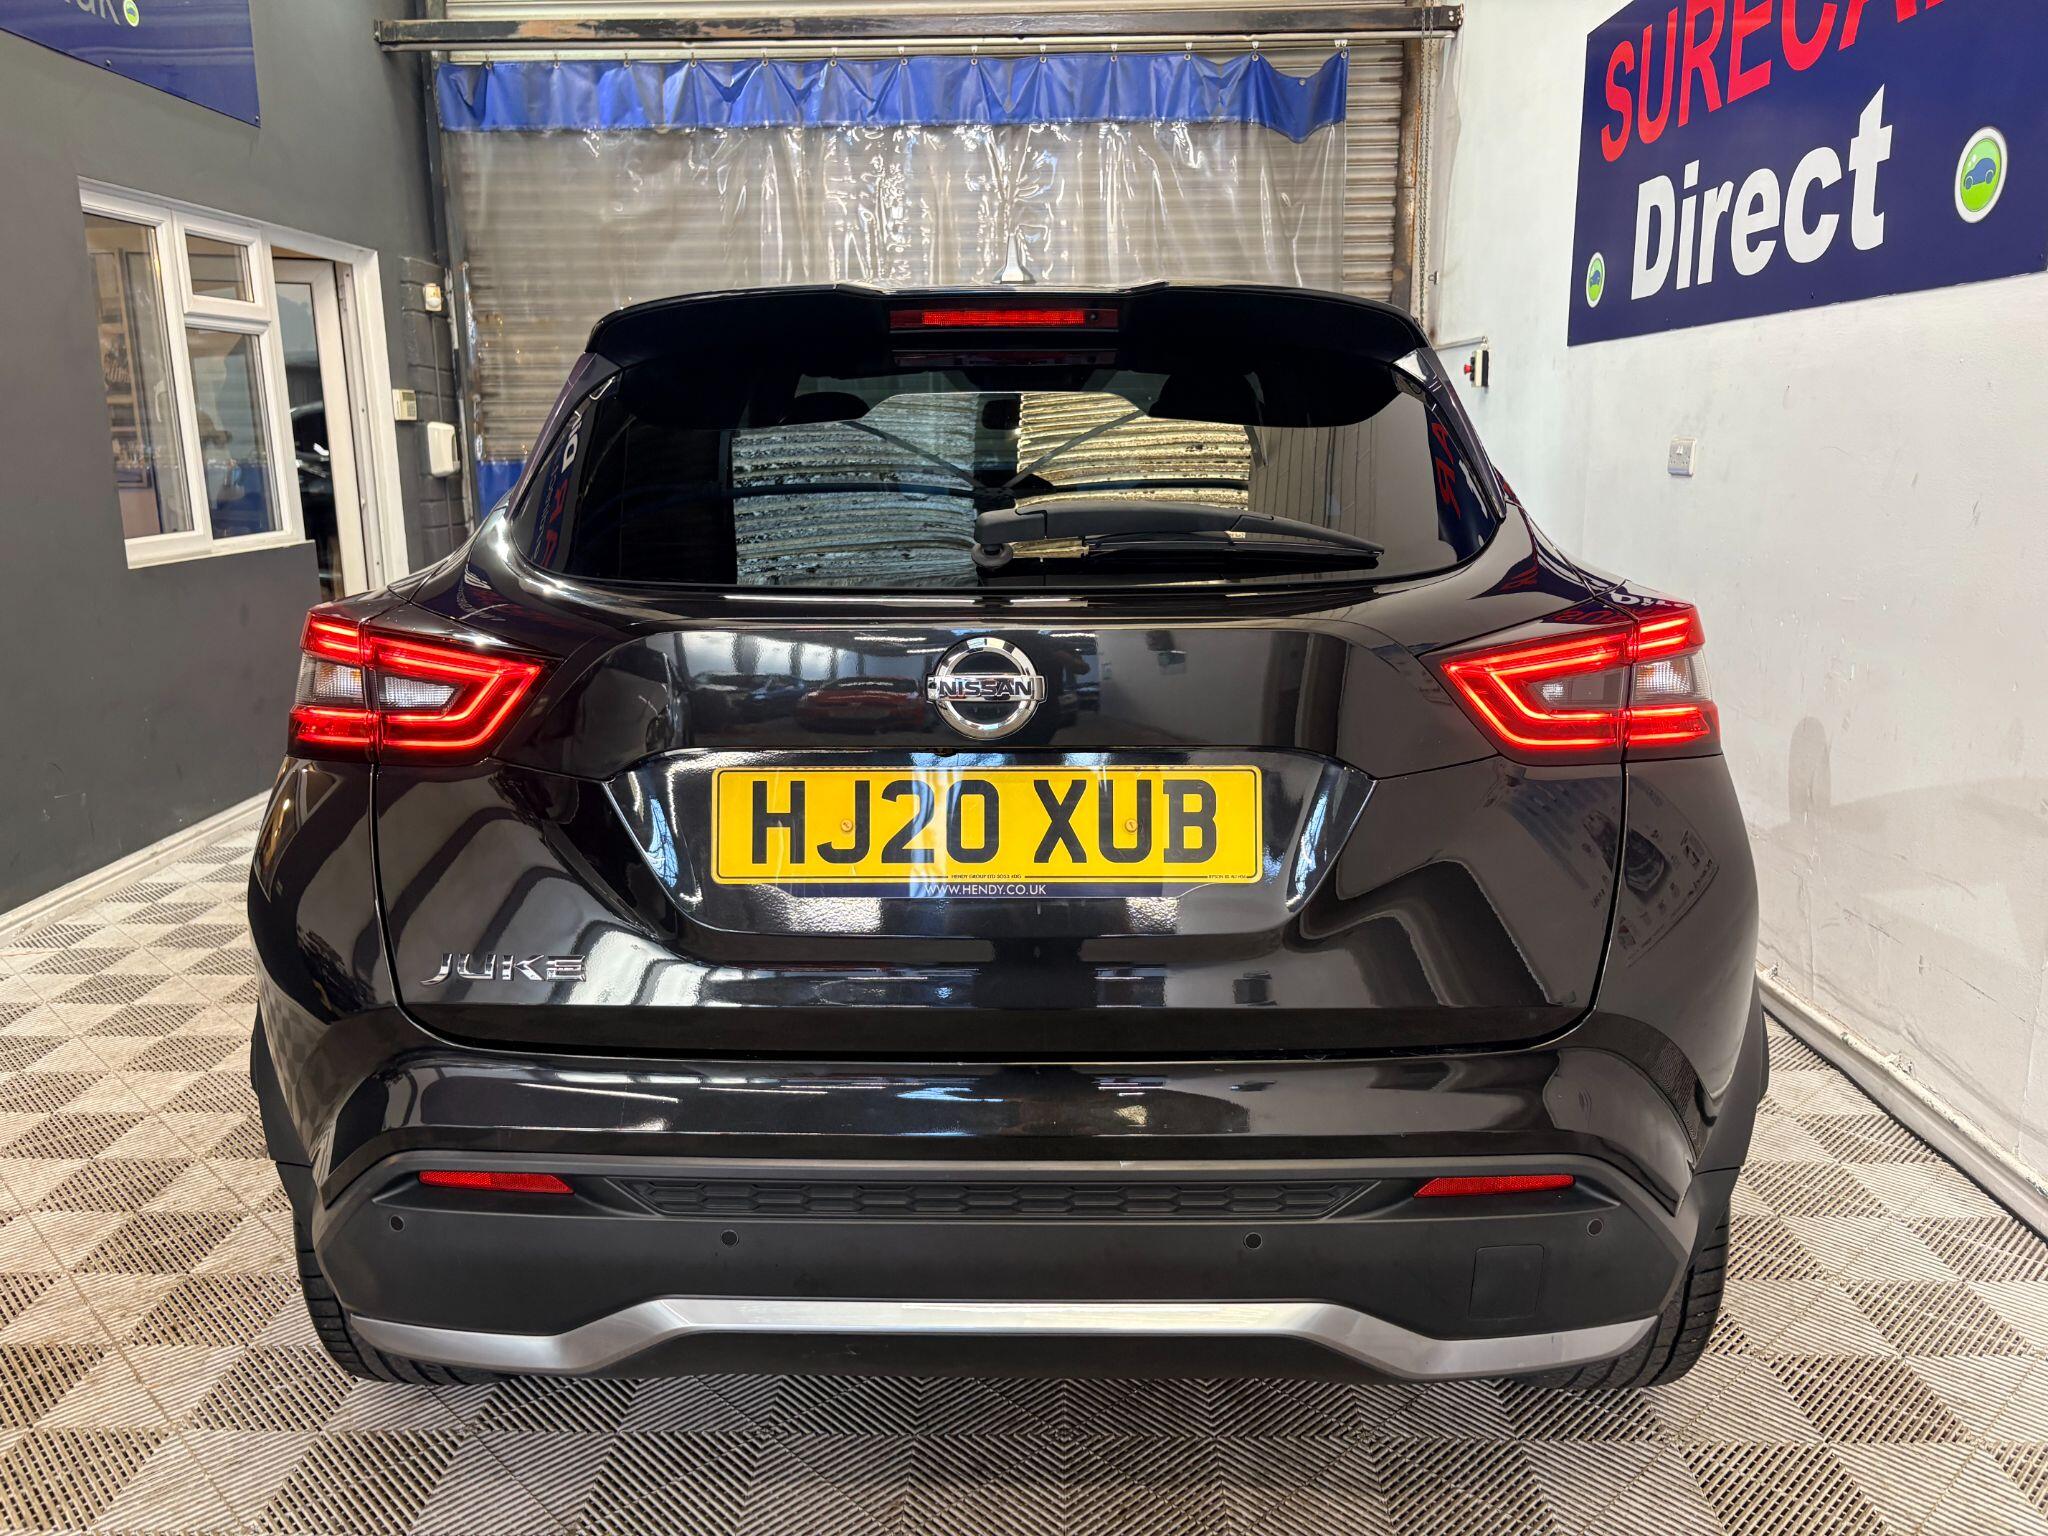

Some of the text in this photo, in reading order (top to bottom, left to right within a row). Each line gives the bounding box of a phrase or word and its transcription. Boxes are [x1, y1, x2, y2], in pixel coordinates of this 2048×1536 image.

[1601, 0, 1945, 162] SUREC
[1631, 83, 1892, 300] Direct
[940, 681, 1032, 696] NISSAN
[752, 780, 1217, 865] HJ20 XUB
[924, 884, 1047, 895] WWW.HENDY.CO.UK
[419, 953, 587, 986] JUKE
